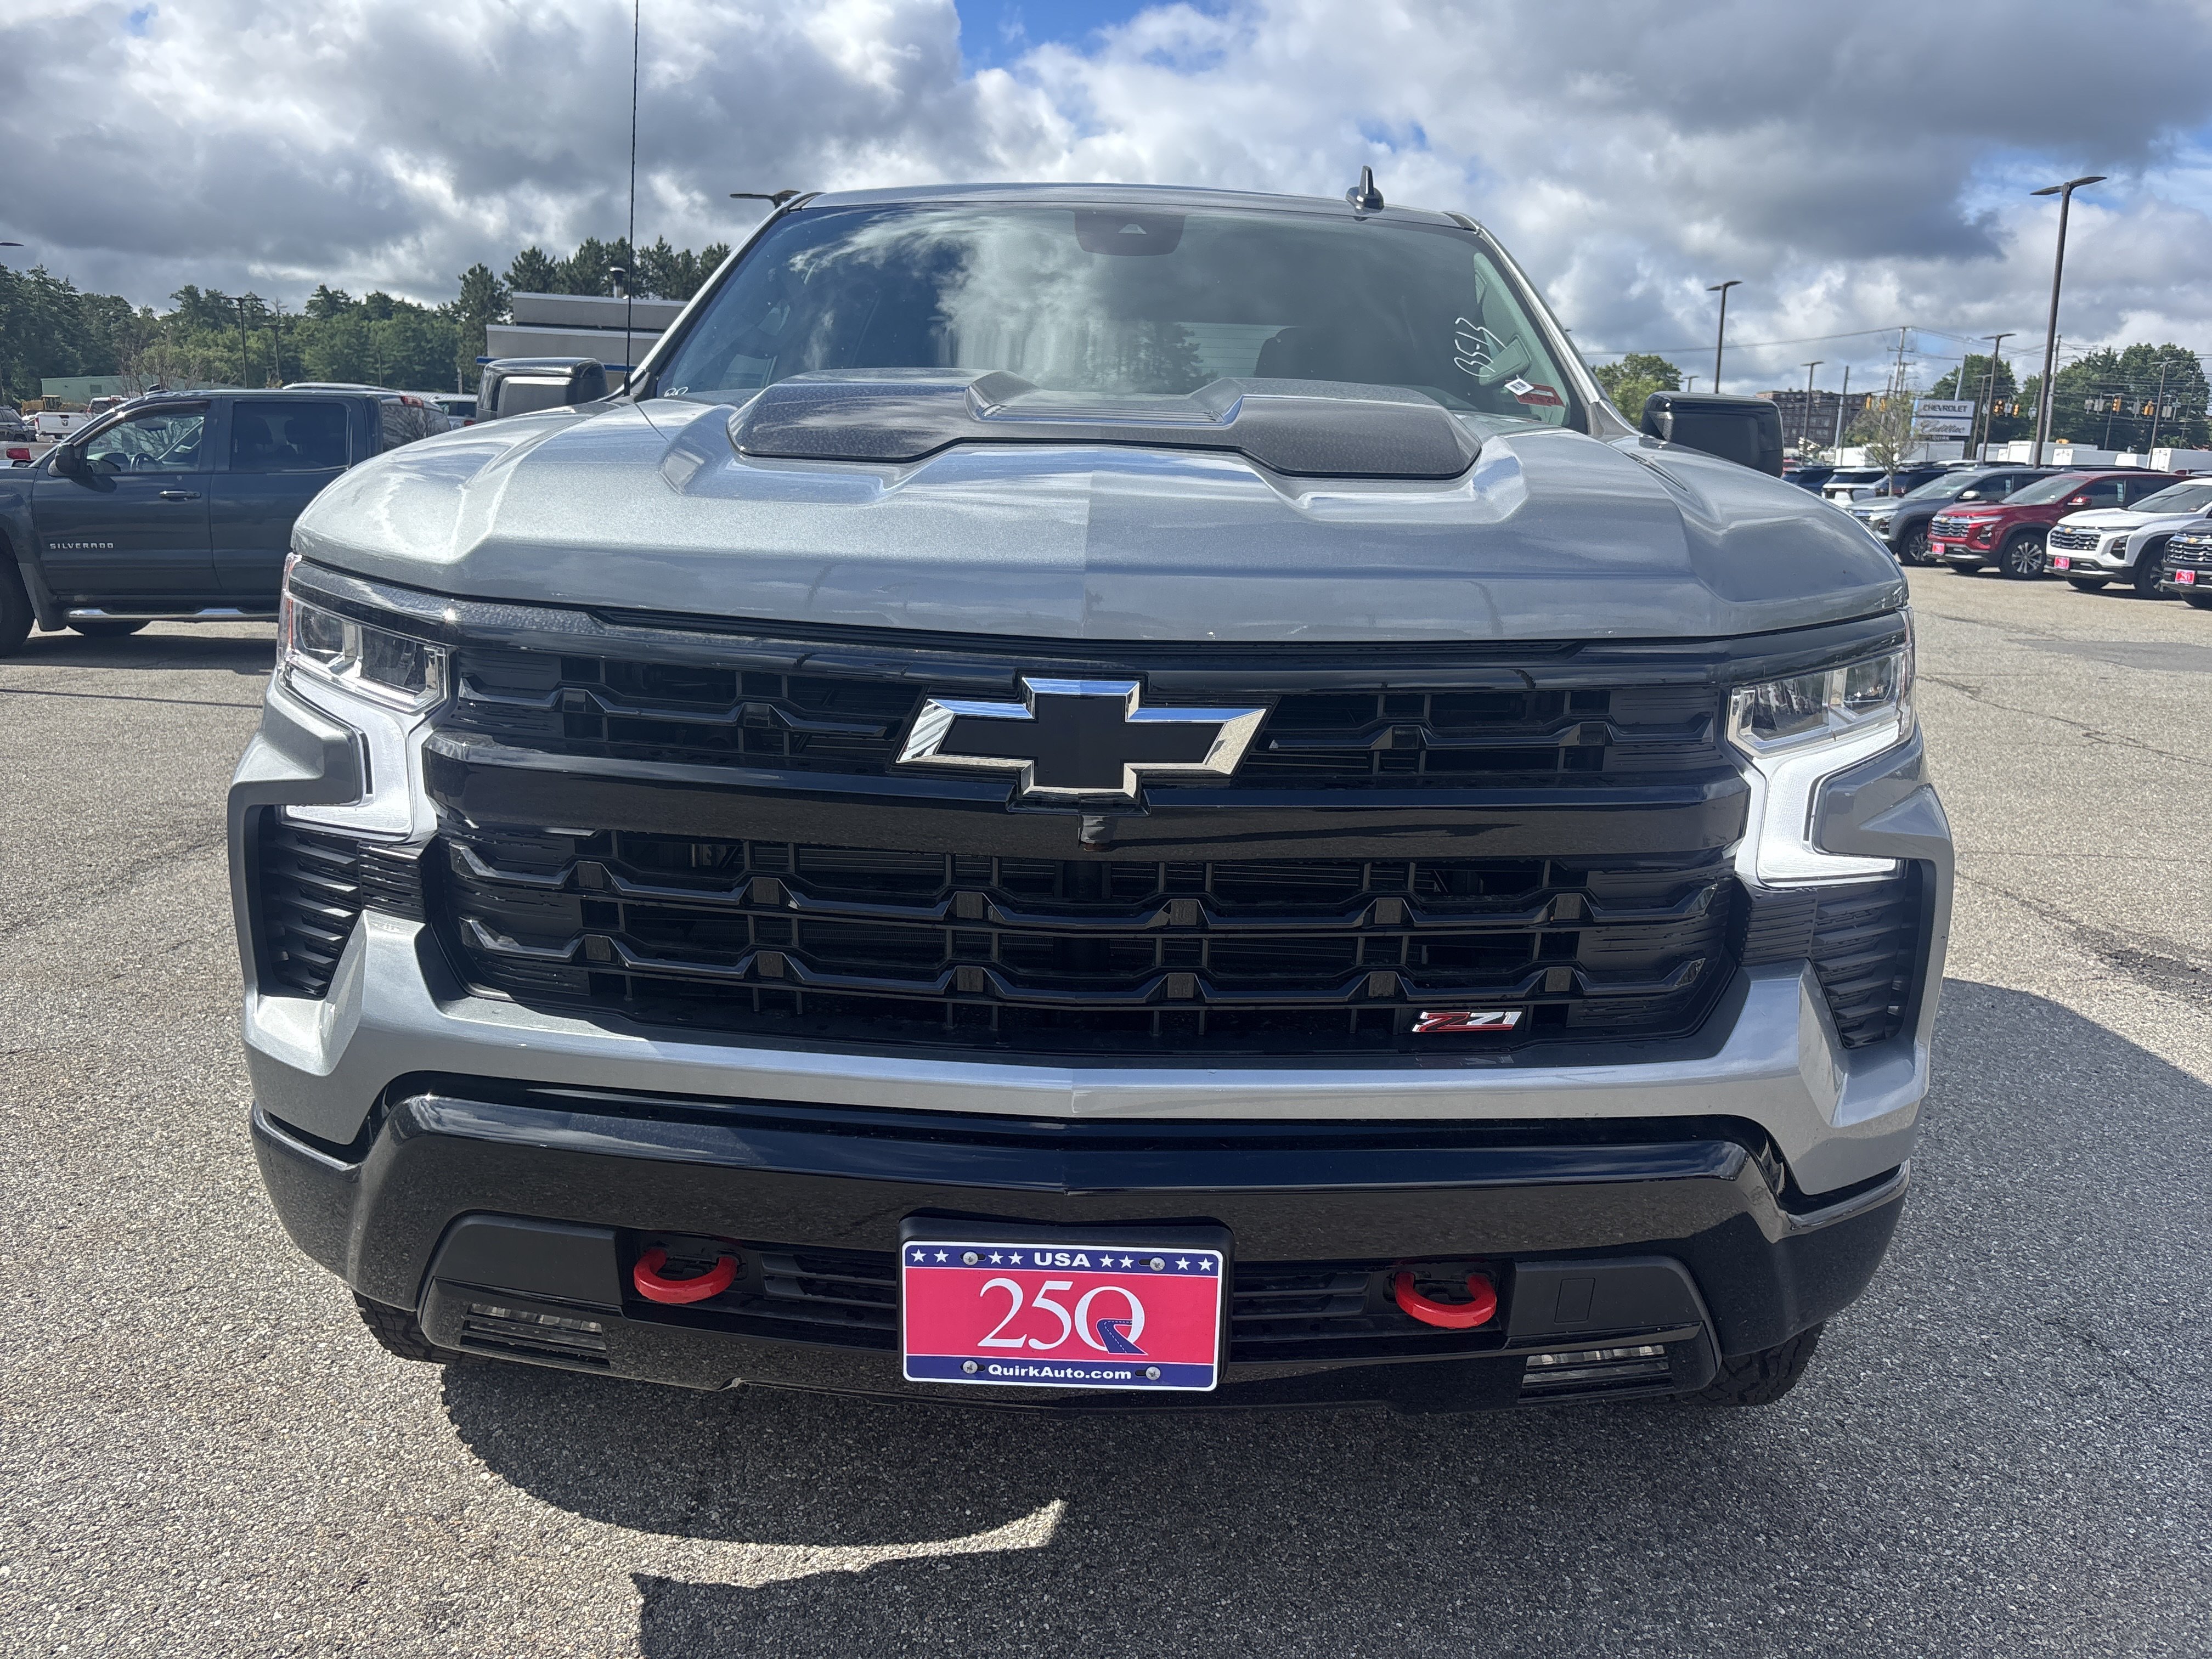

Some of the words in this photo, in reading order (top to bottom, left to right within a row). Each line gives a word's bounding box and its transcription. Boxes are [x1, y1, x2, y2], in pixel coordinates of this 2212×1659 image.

[1923, 403, 1968, 413] CHEVROLET
[1412, 1011, 1522, 1032] Z71
[1034, 1252, 1091, 1267] USA
[988, 1364, 1131, 1379] QuirkAuto.com
